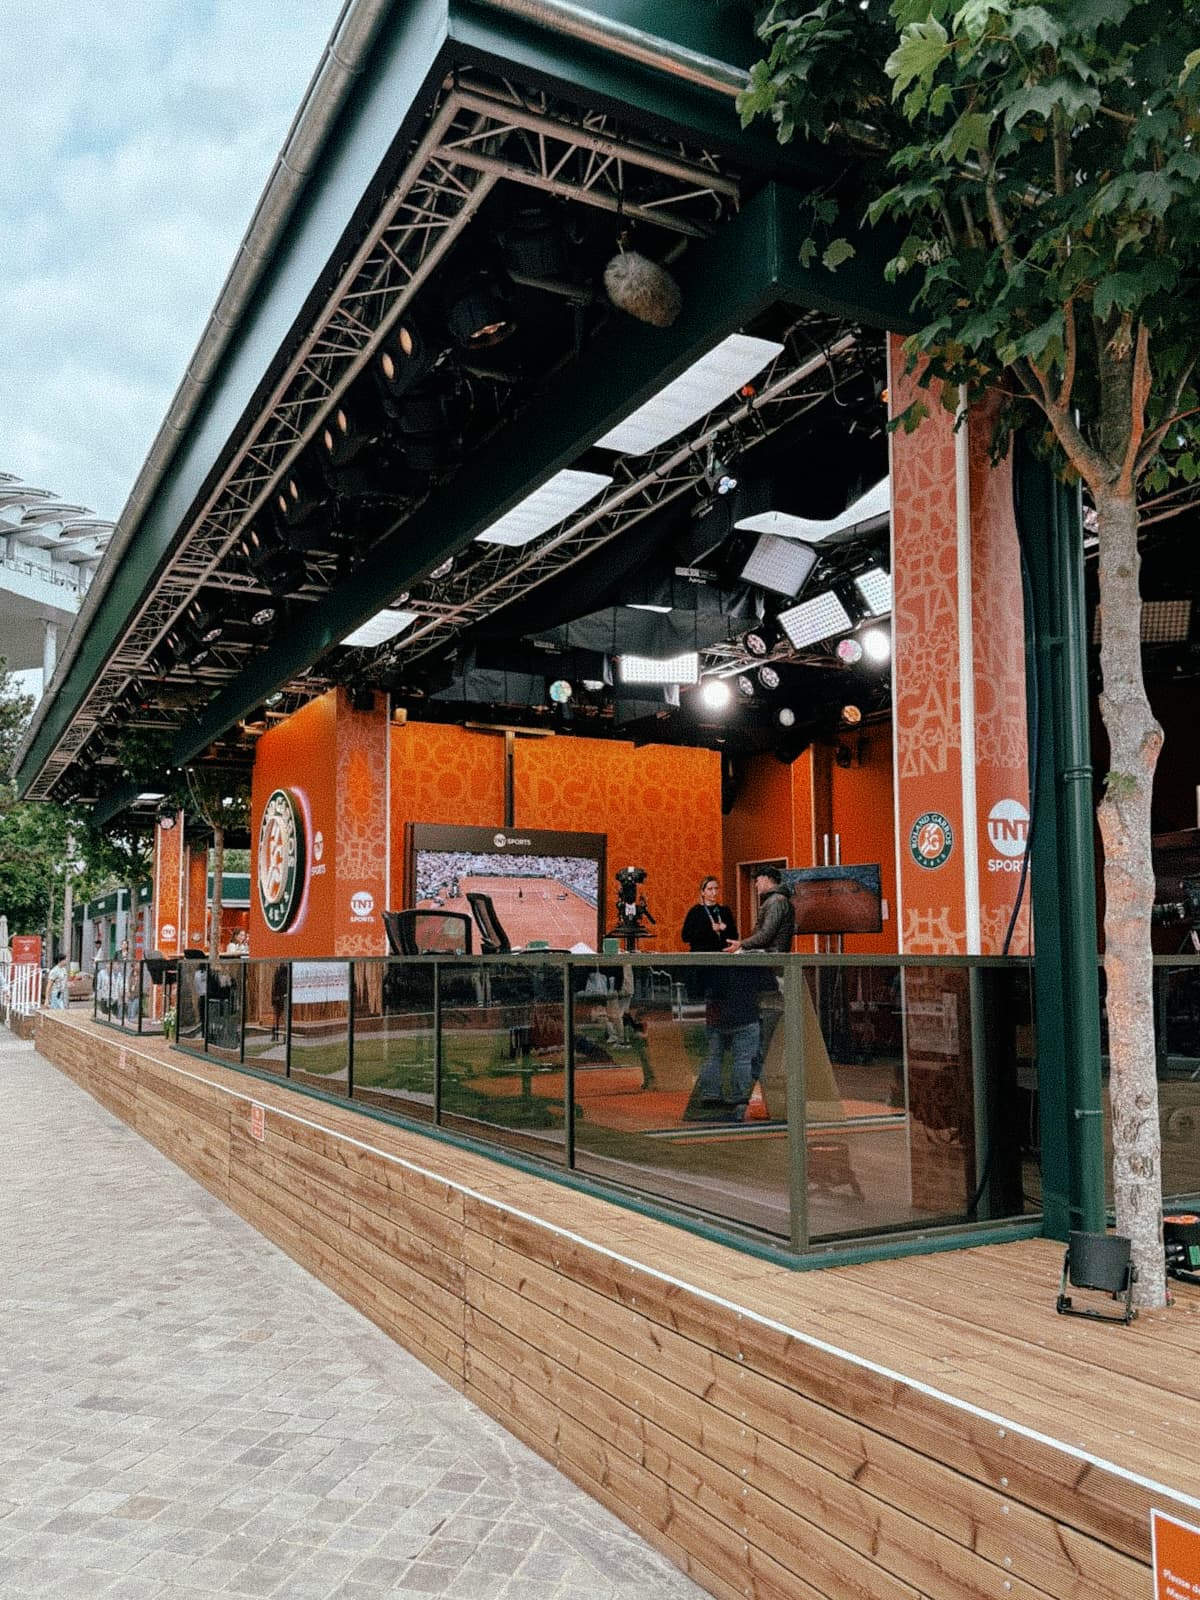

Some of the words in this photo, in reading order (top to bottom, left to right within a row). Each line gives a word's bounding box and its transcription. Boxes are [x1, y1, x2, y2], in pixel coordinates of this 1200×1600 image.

[931, 814, 952, 846] GARROS
[507, 838, 531, 846] SPORTS
[988, 859, 1032, 873] SPOR
